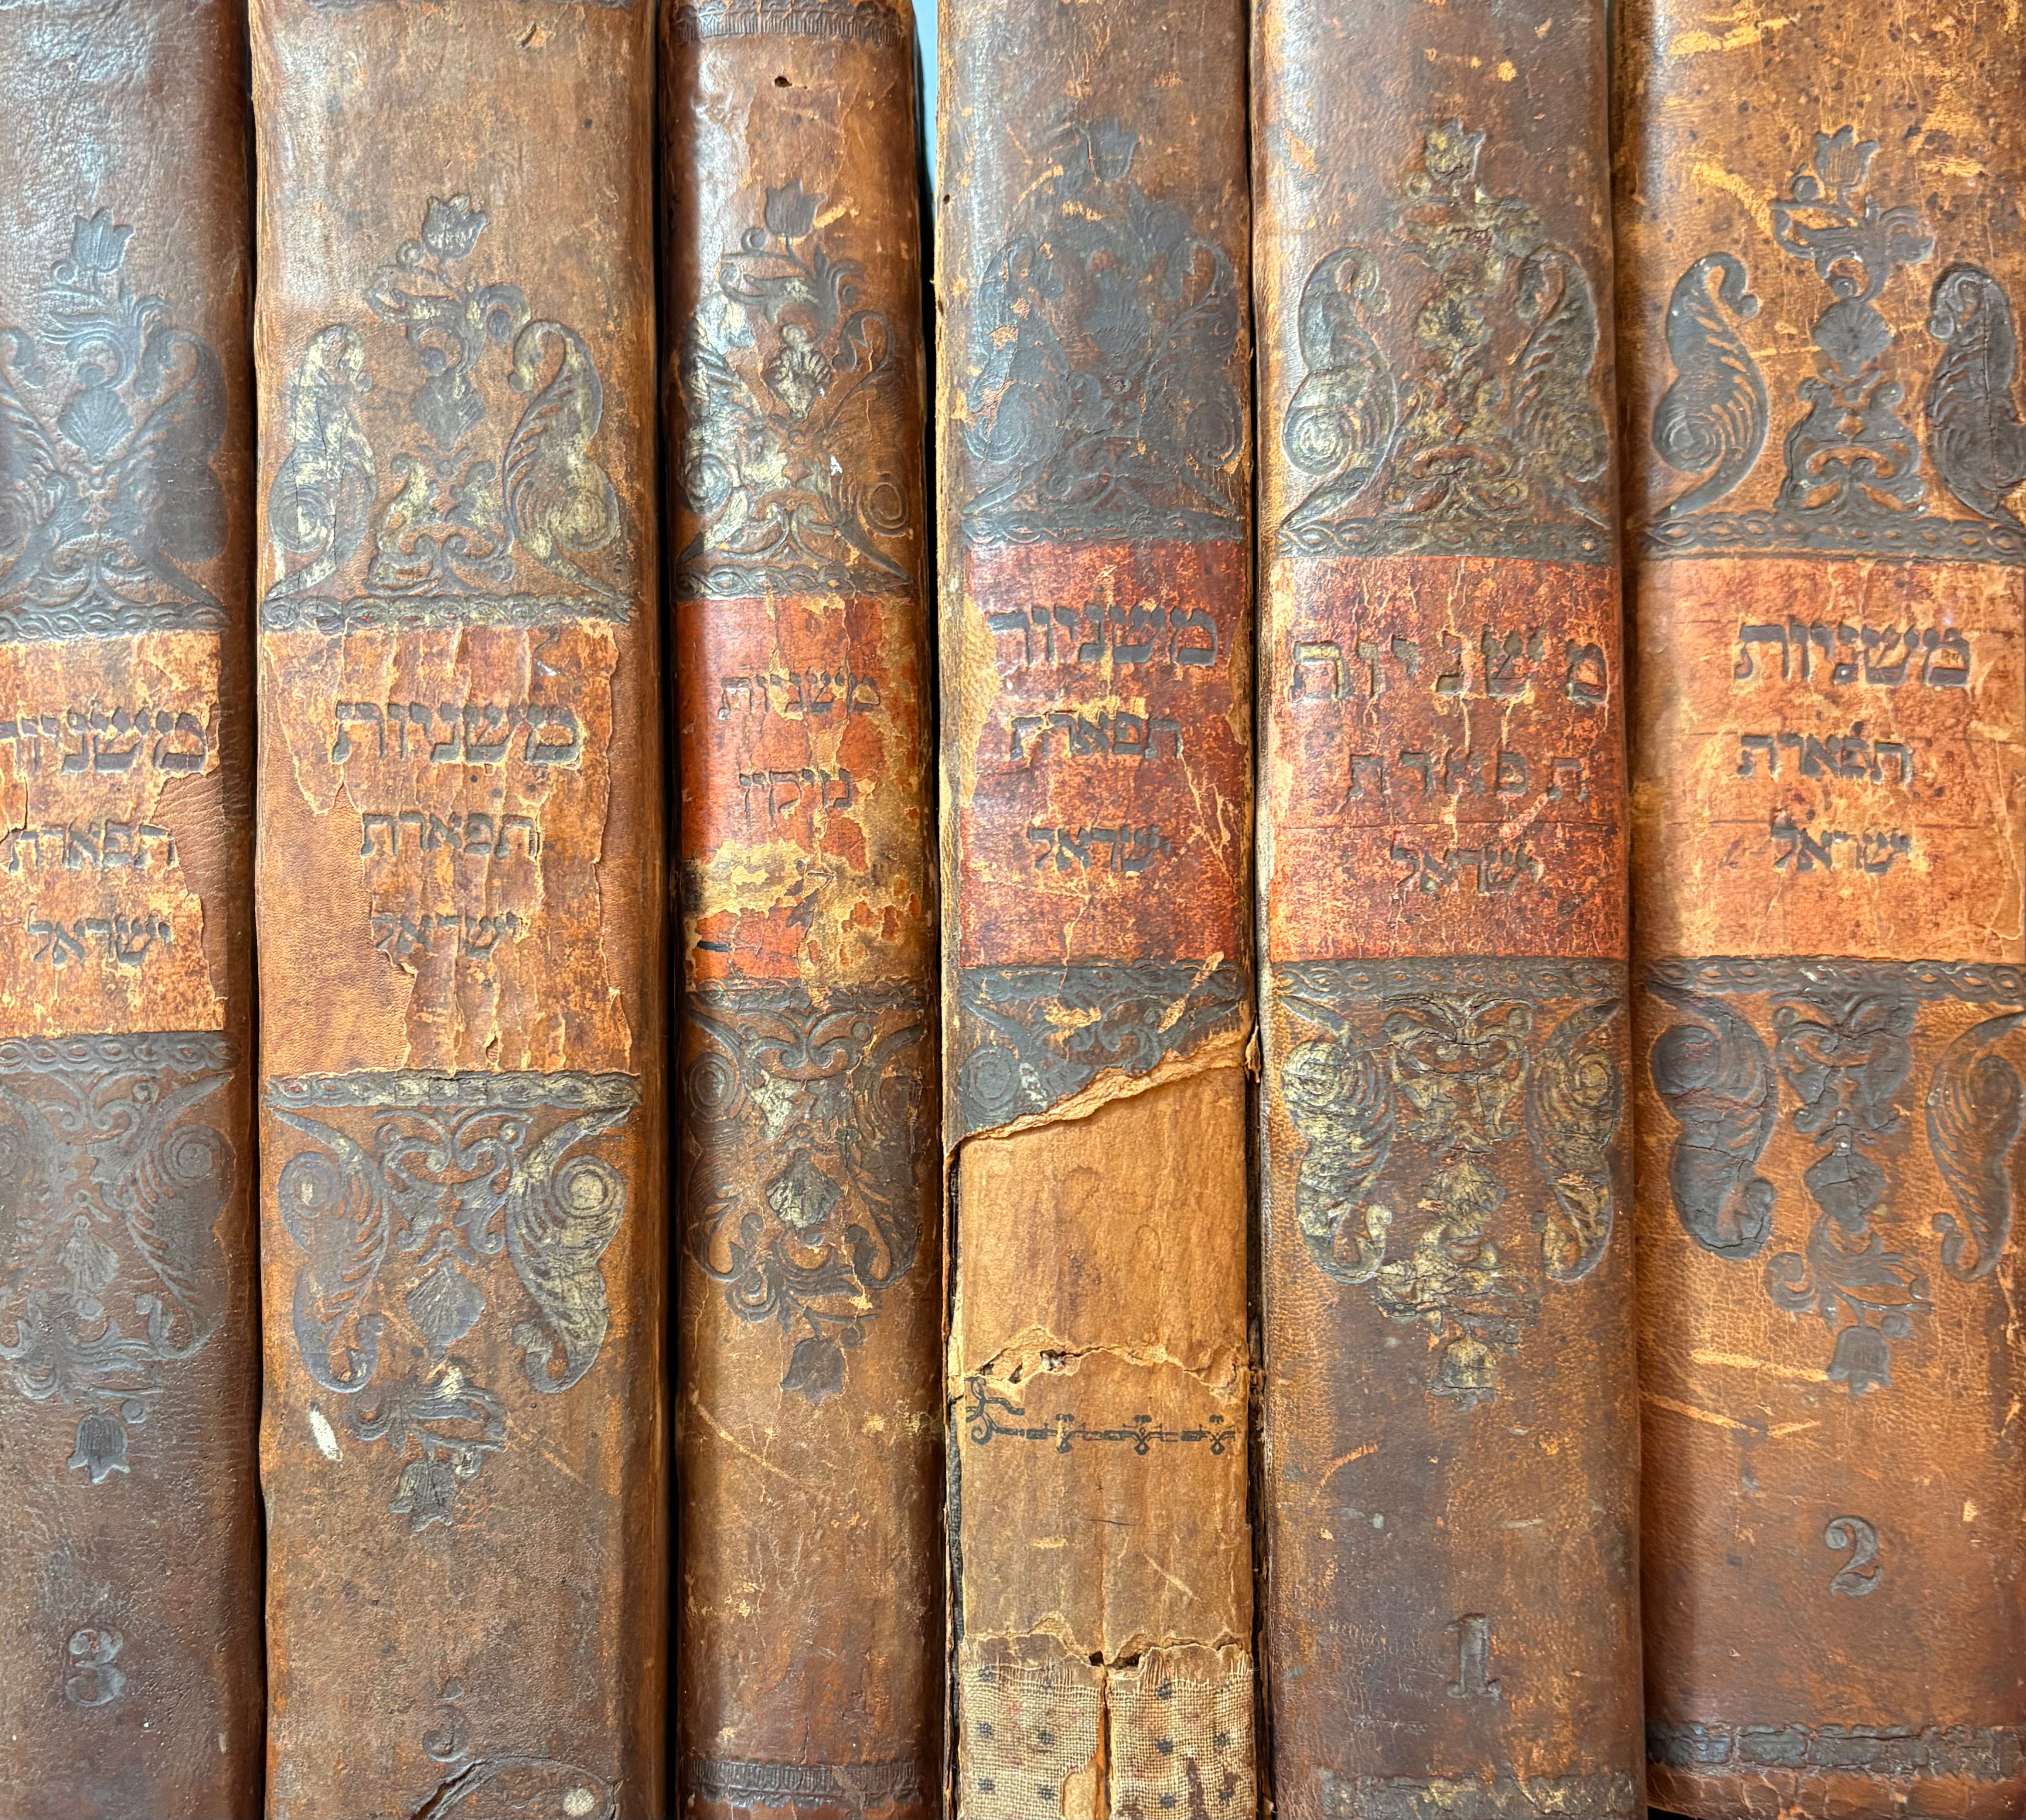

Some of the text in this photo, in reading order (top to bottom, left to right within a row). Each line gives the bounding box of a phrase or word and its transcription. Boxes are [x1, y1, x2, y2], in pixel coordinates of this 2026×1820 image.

[1290, 624, 1607, 704] משניות
[1734, 617, 1971, 687] משניות
[331, 701, 582, 764] משניות
[1010, 711, 1183, 760] תפארת
[1737, 733, 1913, 783] תפארת
[1349, 751, 1589, 802] תפארת
[8, 821, 175, 872] תפארת
[361, 812, 538, 859] תפארת
[1027, 824, 1171, 872] ישראל
[1391, 831, 1543, 895] ישראל
[1771, 807, 1912, 873] ישראל
[27, 902, 171, 966] ישראל
[1823, 1515, 1885, 1598] 2
[1447, 1613, 1500, 1698] 1
